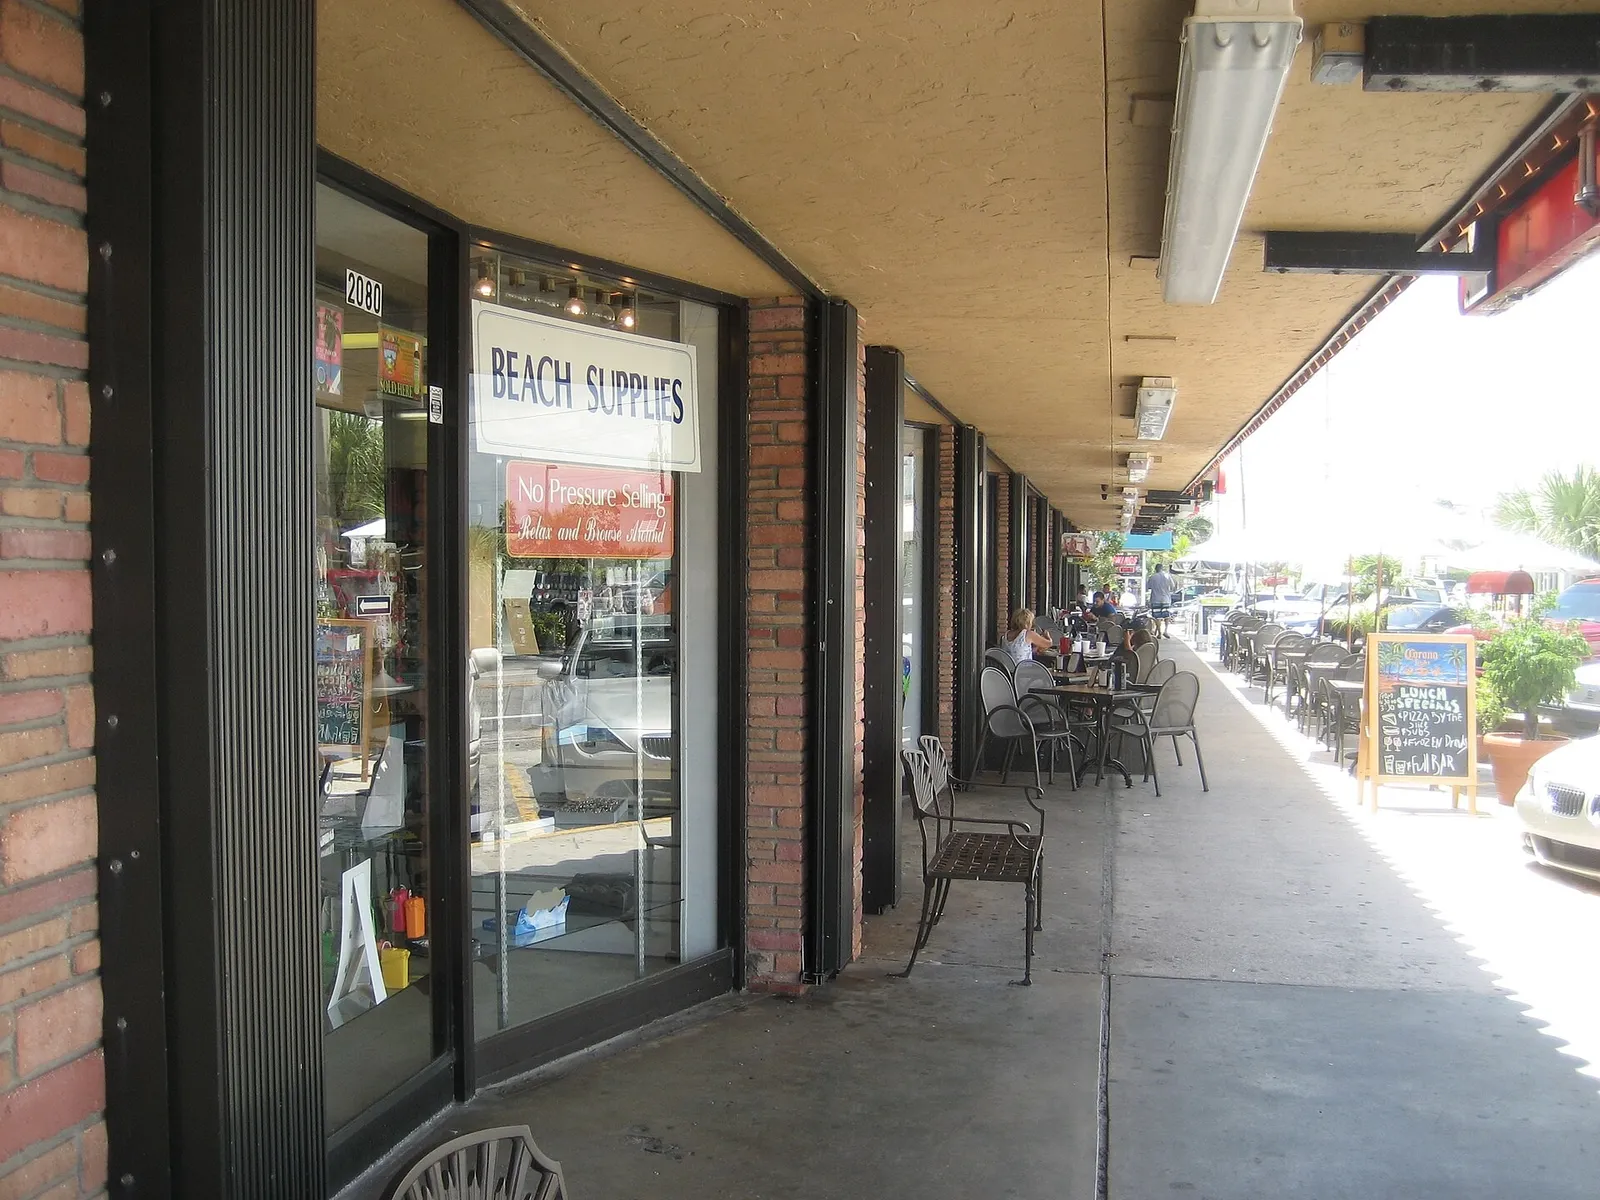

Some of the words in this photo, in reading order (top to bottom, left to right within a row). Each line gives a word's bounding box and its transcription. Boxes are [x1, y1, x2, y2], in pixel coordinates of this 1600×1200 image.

[348, 272, 382, 314] 2080
[379, 377, 396, 394] SOLD
[397, 382, 413, 399] HERE
[491, 347, 572, 409] BEACH
[586, 364, 684, 425] SUPPLIES
[518, 476, 544, 503] No
[550, 478, 616, 507] Pressure
[622, 483, 666, 518] Selling
[518, 515, 553, 541] Relax
[557, 517, 582, 541] and
[584, 517, 622, 542] Browse
[1404, 648, 1439, 660] Corona
[1396, 697, 1459, 713] SPECIALS
[1400, 687, 1447, 701] LUNCH
[1402, 711, 1429, 722] PIZZA
[1430, 753, 1456, 776] BAR
